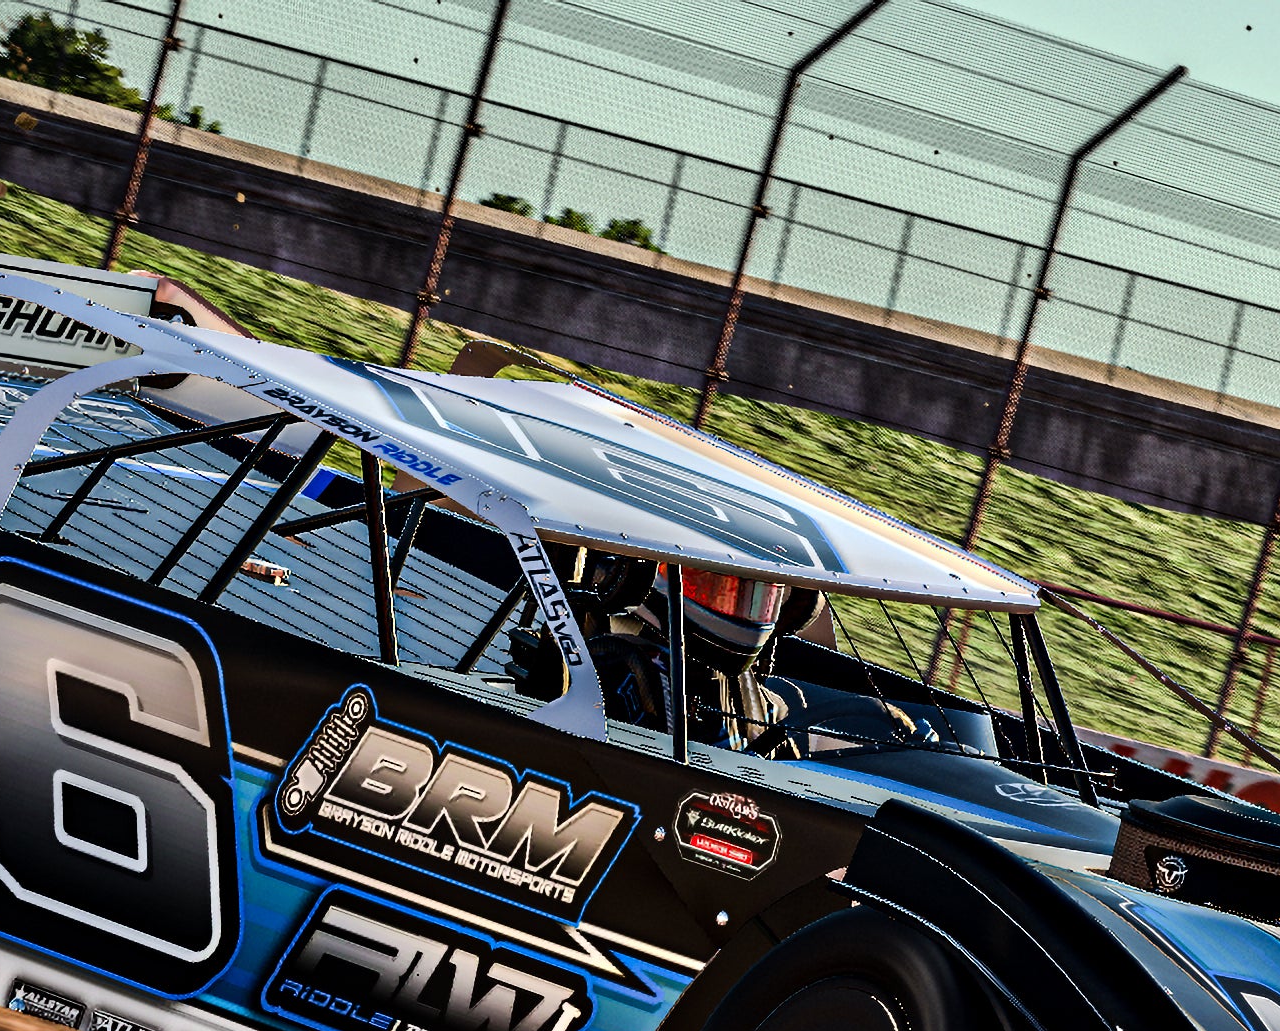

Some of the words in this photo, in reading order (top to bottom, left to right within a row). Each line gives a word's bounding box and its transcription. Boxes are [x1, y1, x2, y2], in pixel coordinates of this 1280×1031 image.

[262, 387, 381, 443] BRAYSON
[373, 442, 463, 486] RIDDLE
[318, 800, 394, 839] BRAYSON
[394, 826, 452, 861] RIDDLE
[454, 846, 576, 904] MOTORSPORTS
[323, 725, 624, 887] BRM
[279, 978, 394, 1030] RIDDLE
